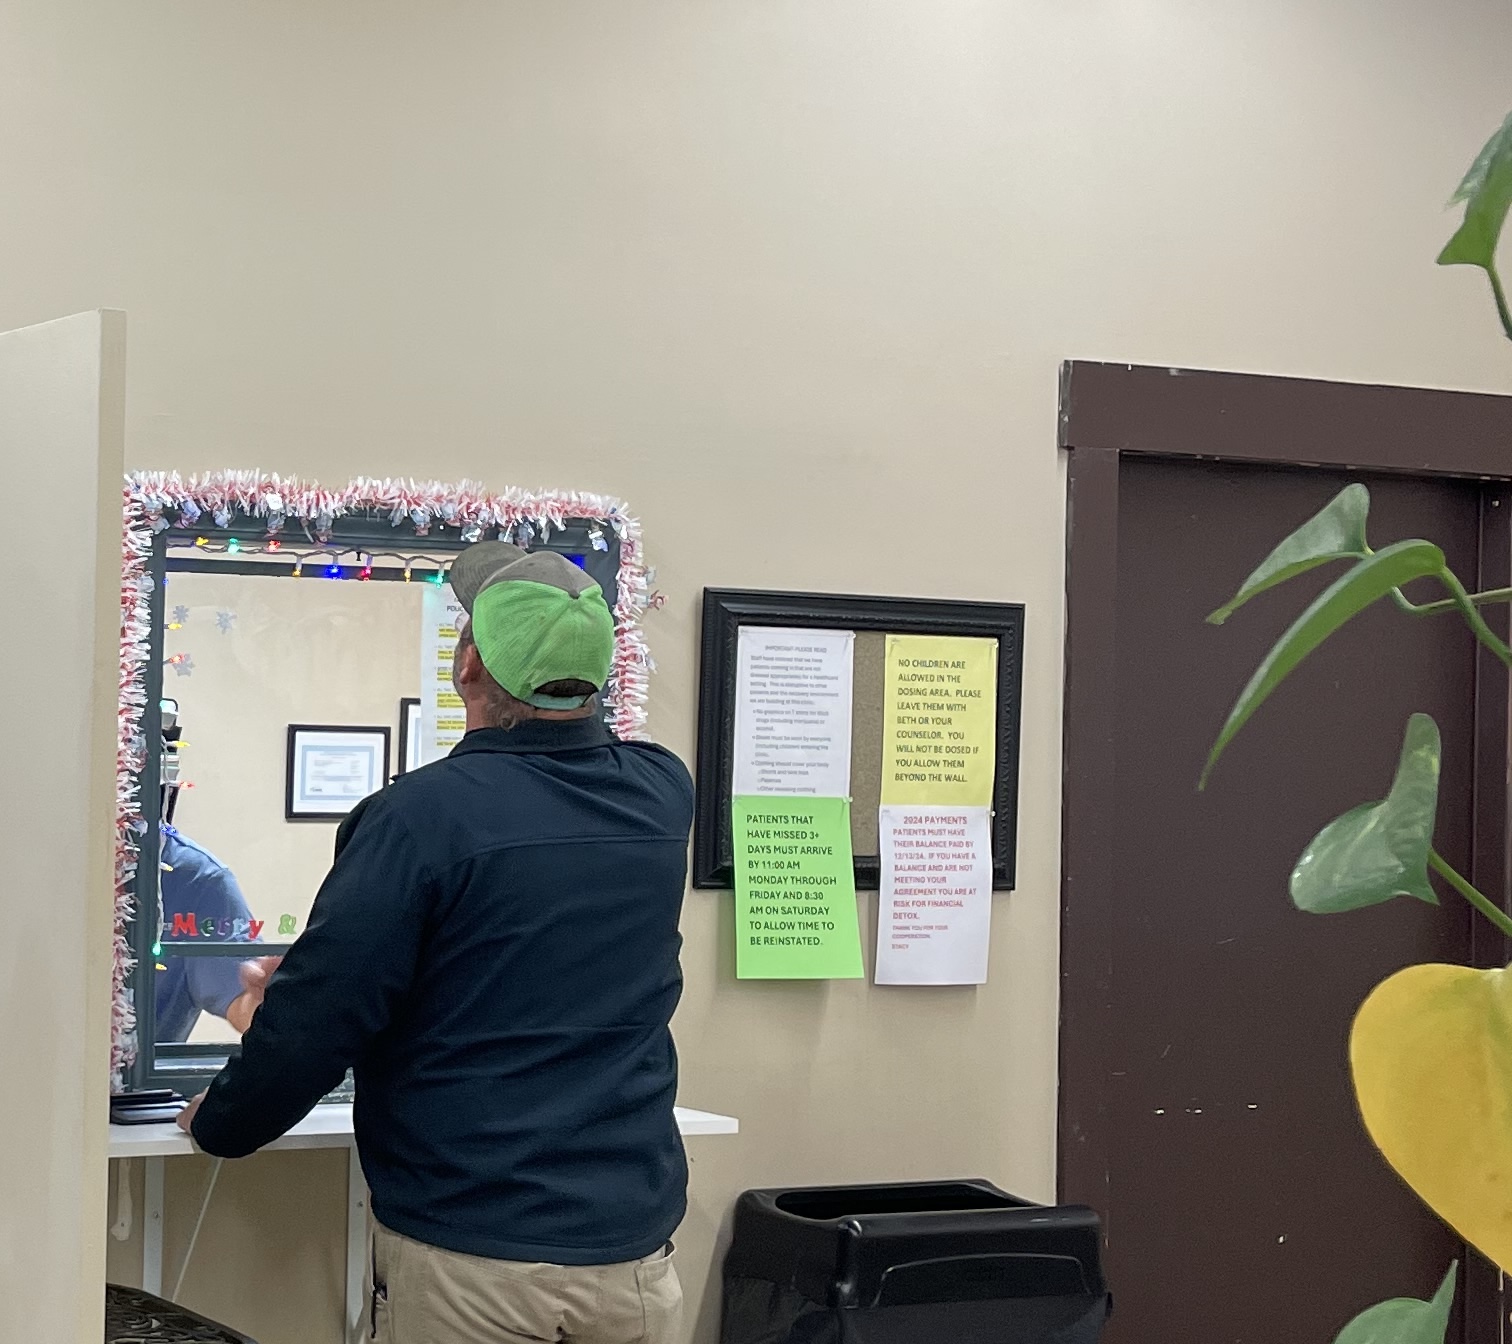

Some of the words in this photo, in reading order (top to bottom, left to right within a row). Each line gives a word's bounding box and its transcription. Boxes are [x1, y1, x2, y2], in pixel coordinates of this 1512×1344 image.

[899, 659, 910, 667] NO
[912, 659, 949, 668] CHILDREN
[951, 661, 966, 669] ARE
[898, 674, 935, 682] ALLOWED
[947, 675, 961, 683] THE
[898, 688, 927, 696] DOSING
[956, 690, 981, 698] PLEASE
[897, 702, 920, 710] LEAVE
[923, 703, 944, 711] THEM
[946, 703, 966, 711] WITH
[897, 716, 916, 724] BETH
[931, 717, 952, 725] YOUR
[896, 745, 914, 753] WILL
[916, 745, 932, 753] NOT
[945, 746, 970, 754] DOSED
[896, 759, 912, 767] YOU
[943, 760, 964, 768] THEM
[895, 773, 926, 781] BEYOND
[747, 815, 789, 824] PATIENTS
[791, 816, 813, 824] THAT
[904, 816, 923, 824] 2024
[925, 816, 967, 824] PAYMENTS
[773, 831, 807, 839] MISSED
[748, 845, 771, 854] DAYS
[774, 846, 798, 854] MUST
[800, 847, 833, 855] ARRIVE
[748, 861, 758, 869] BY
[762, 861, 784, 869] 11:00
[787, 861, 800, 869] AM
[749, 876, 788, 884] MONDAY
[791, 876, 837, 885] THROUGH
[750, 891, 780, 899] FRIDAY
[783, 891, 802, 899] AND
[765, 906, 778, 914] ON
[781, 907, 830, 915] SATURDAY
[171, 913, 264, 940] Merry
[750, 922, 761, 930] TO
[764, 922, 796, 930] ALLOW
[798, 922, 819, 930] TIME
[822, 922, 834, 930] TO
[750, 937, 761, 945] BE
[764, 937, 823, 945] REINSTATED.
